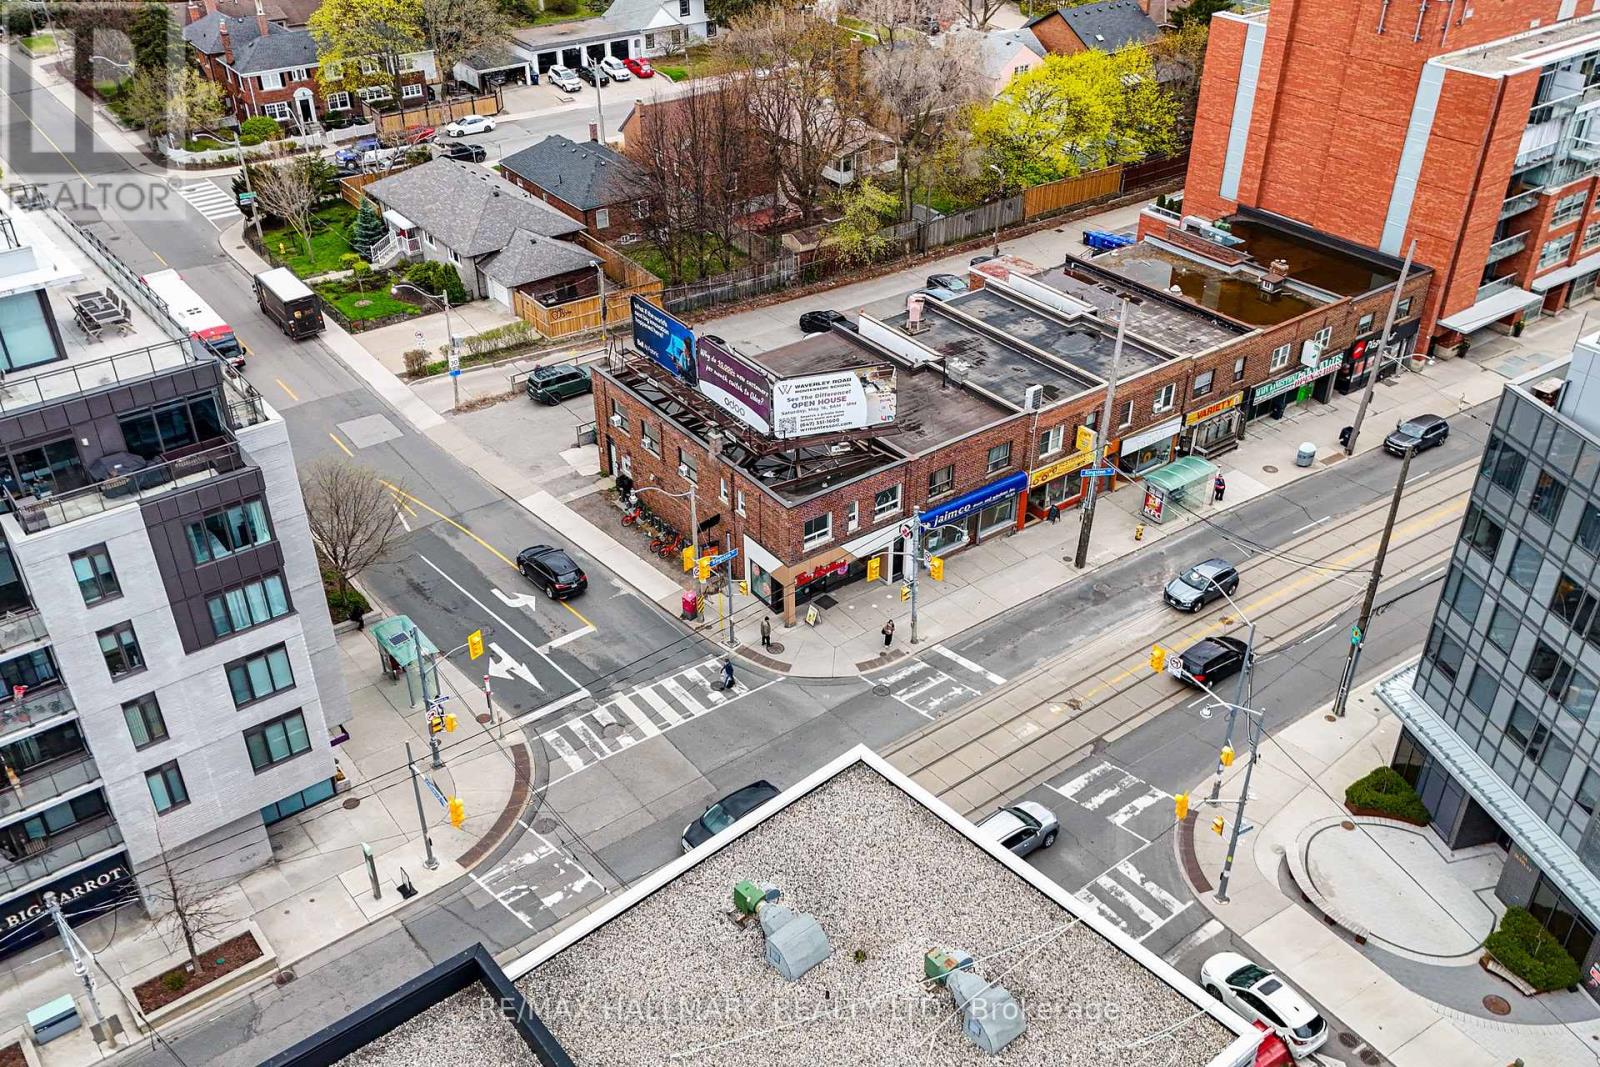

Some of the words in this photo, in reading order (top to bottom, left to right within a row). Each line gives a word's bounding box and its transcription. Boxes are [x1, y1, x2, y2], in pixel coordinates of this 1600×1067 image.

[700, 348, 711, 362] Why
[711, 355, 717, 363] do
[736, 373, 745, 382] new
[746, 379, 769, 397] customers
[713, 370, 728, 383] month
[794, 380, 831, 389] WAVERLEY
[794, 386, 829, 394] MONTESSORI
[724, 397, 746, 417] odoo
[791, 400, 816, 409] OPEN
[817, 396, 847, 405] HOUSE
[1197, 399, 1232, 420] VARIETY
[933, 503, 971, 527] jaimco
[1144, 507, 1161, 519] KFC
[5, 904, 41, 928] BIG
[47, 867, 121, 907] ARROT
